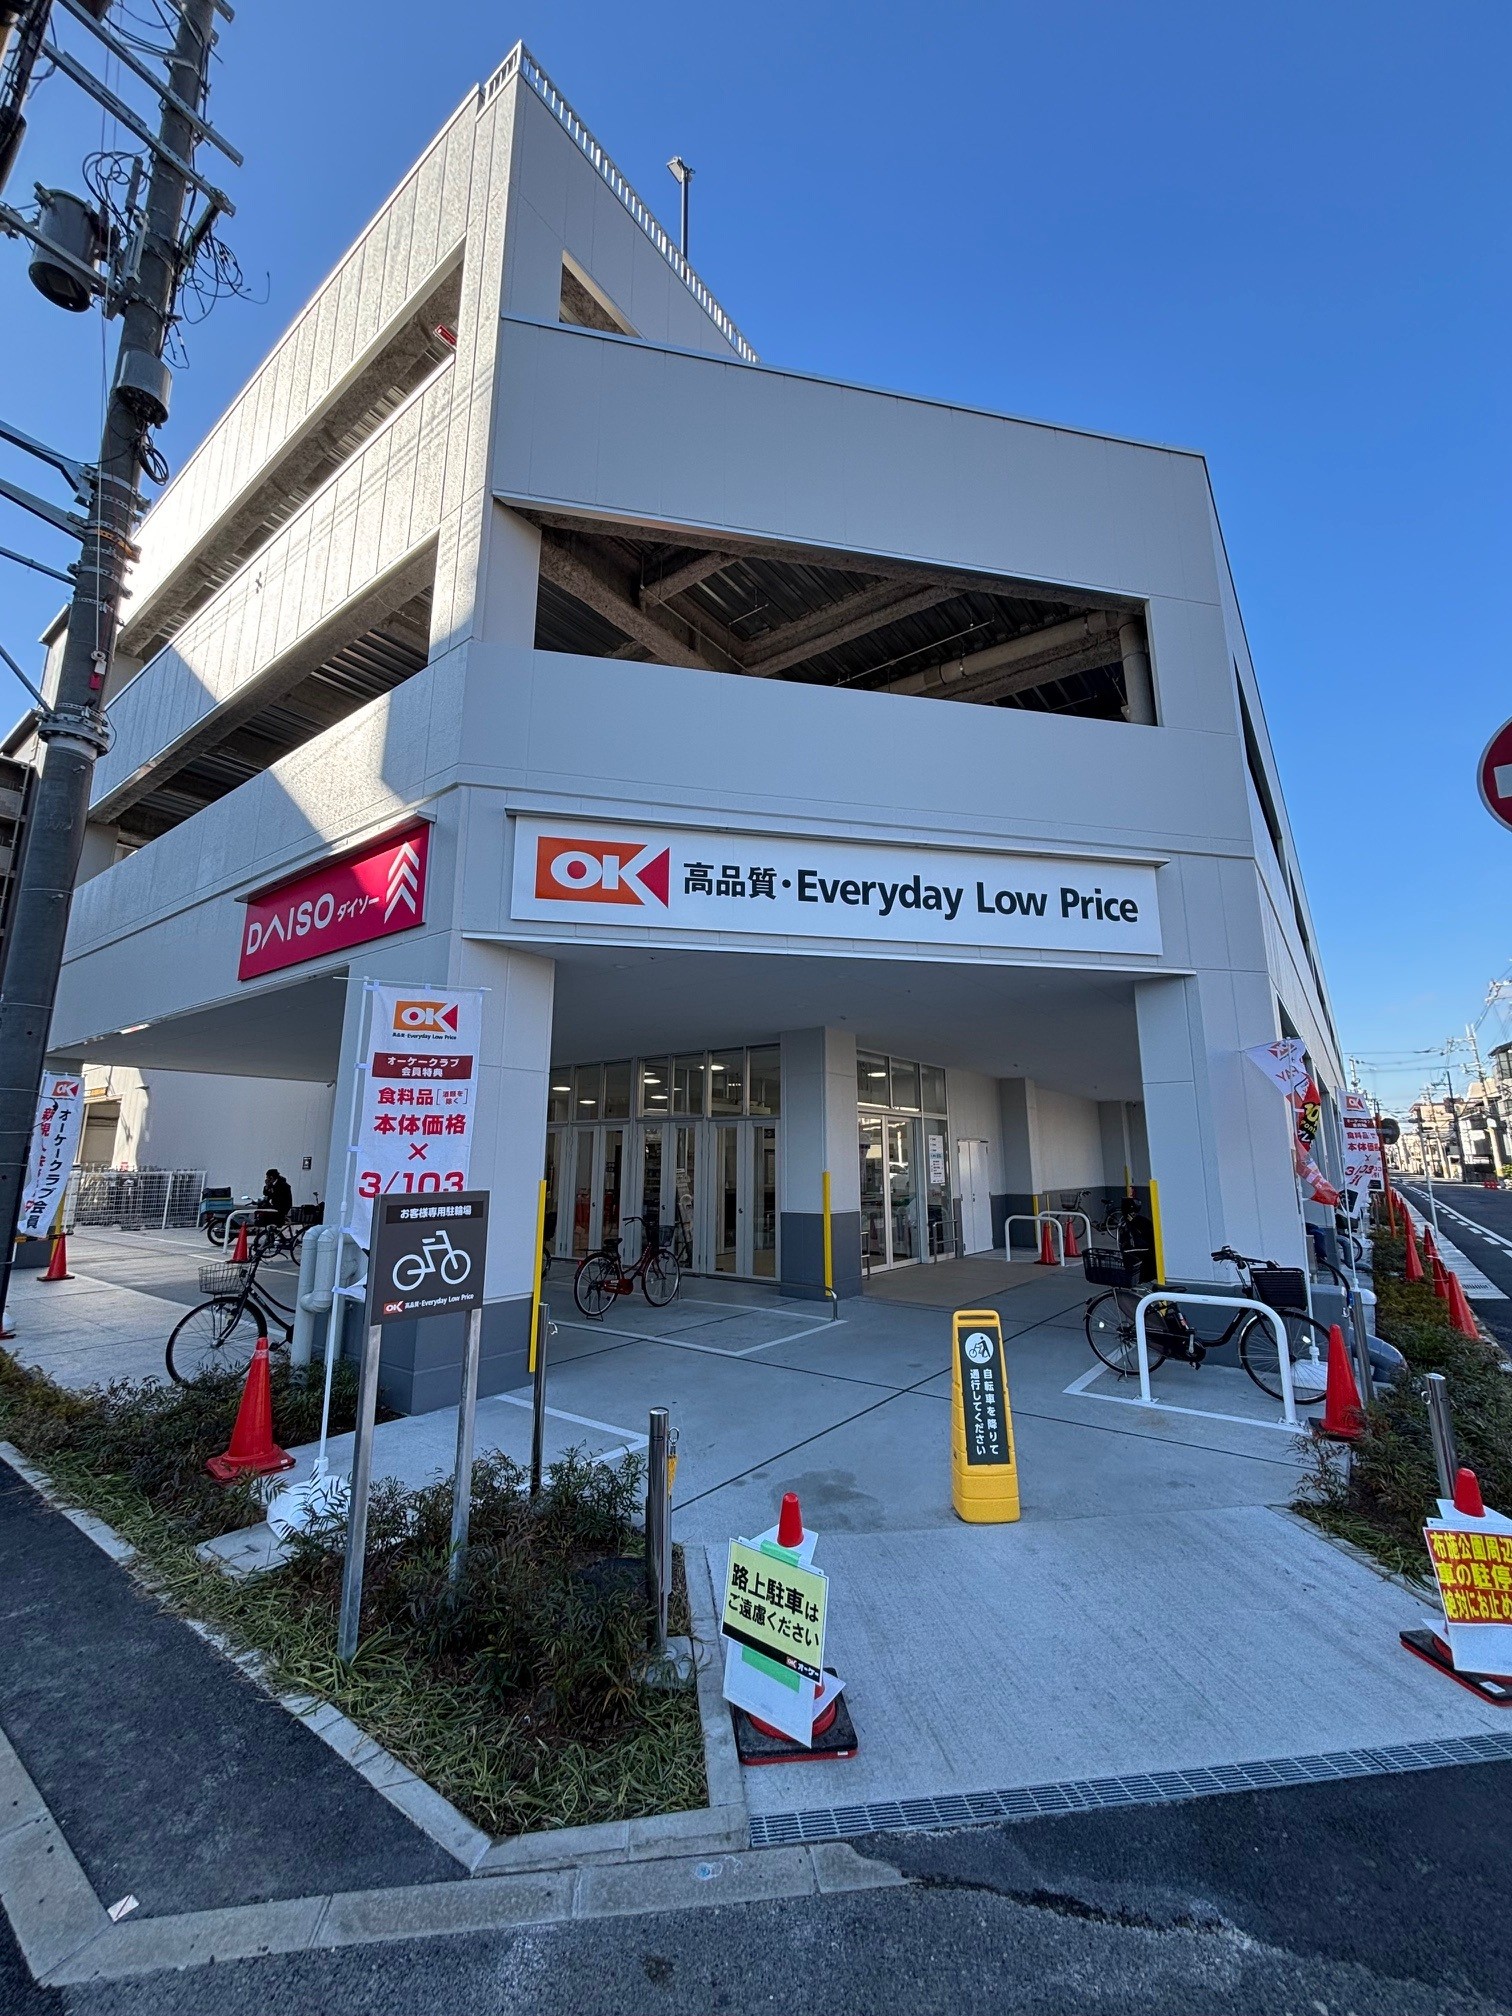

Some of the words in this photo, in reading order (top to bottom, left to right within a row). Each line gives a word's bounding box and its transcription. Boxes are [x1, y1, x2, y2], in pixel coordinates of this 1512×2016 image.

[550, 843, 668, 907] OK
[976, 881, 1047, 917] Low
[1060, 887, 1139, 923] Price
[246, 893, 335, 956] DAISO
[337, 895, 380, 922] ダイソー
[401, 1003, 458, 1032] OK
[387, 1056, 459, 1067] オーケークラブ
[378, 1087, 434, 1106] 食料品
[373, 1113, 466, 1136] 本体価格
[358, 1171, 464, 1199] 3/103
[400, 1205, 472, 1219] お客様専用駐輪場
[385, 1301, 404, 1313] OK
[461, 1293, 475, 1301] Price
[970, 1368, 986, 1456] 通行してください
[983, 1368, 999, 1455] 自転車を降りて
[731, 1562, 819, 1623] 路上駐車は
[728, 1592, 820, 1648] ご遠慮ください
[797, 1663, 820, 1677] オーケー
